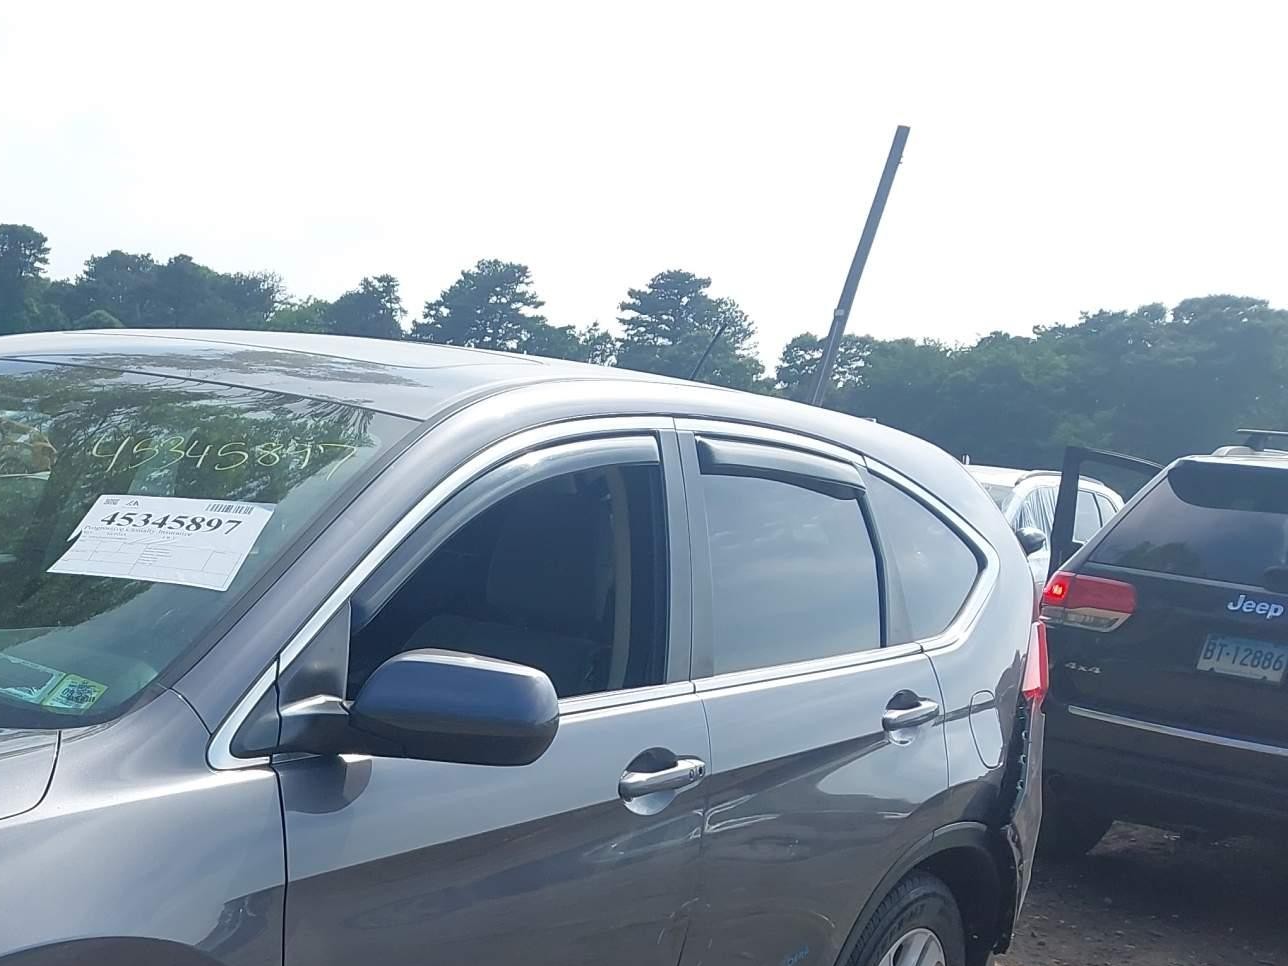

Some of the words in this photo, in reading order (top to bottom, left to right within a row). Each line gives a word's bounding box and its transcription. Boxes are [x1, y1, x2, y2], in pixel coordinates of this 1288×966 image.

[100, 512, 242, 535] 45345897
[1227, 594, 1284, 619] Jeep
[1064, 662, 1102, 674] 4x4
